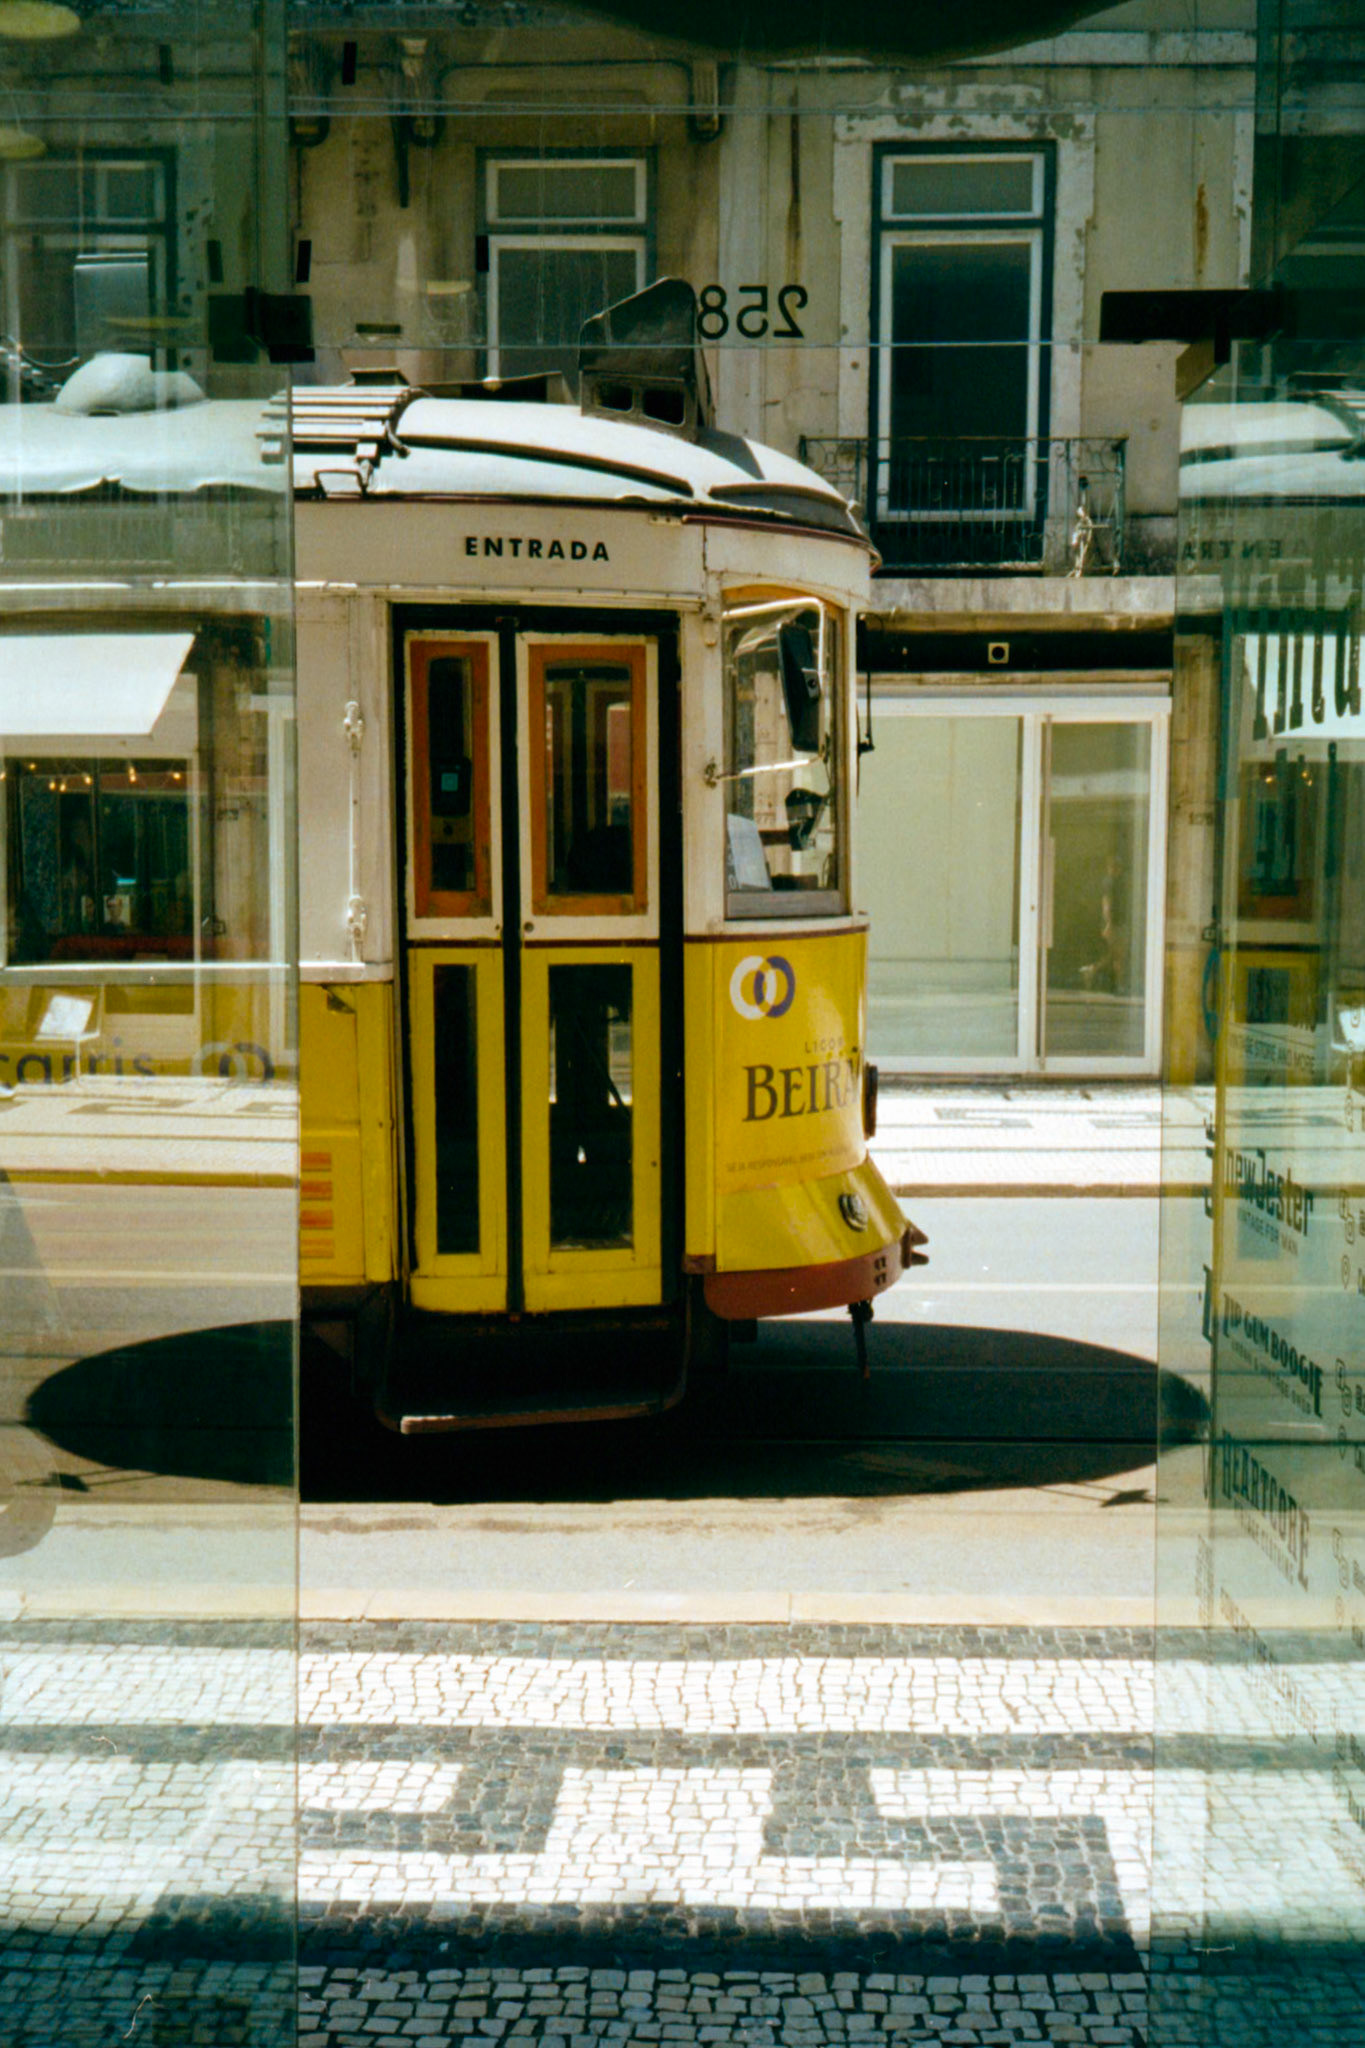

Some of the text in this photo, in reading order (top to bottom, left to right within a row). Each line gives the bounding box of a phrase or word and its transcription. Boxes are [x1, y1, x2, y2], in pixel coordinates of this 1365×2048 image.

[465, 536, 610, 562] ENTRADA
[1271, 1329, 1323, 1419] BOOGIE
[1222, 1429, 1310, 1592] HEARTCORE
